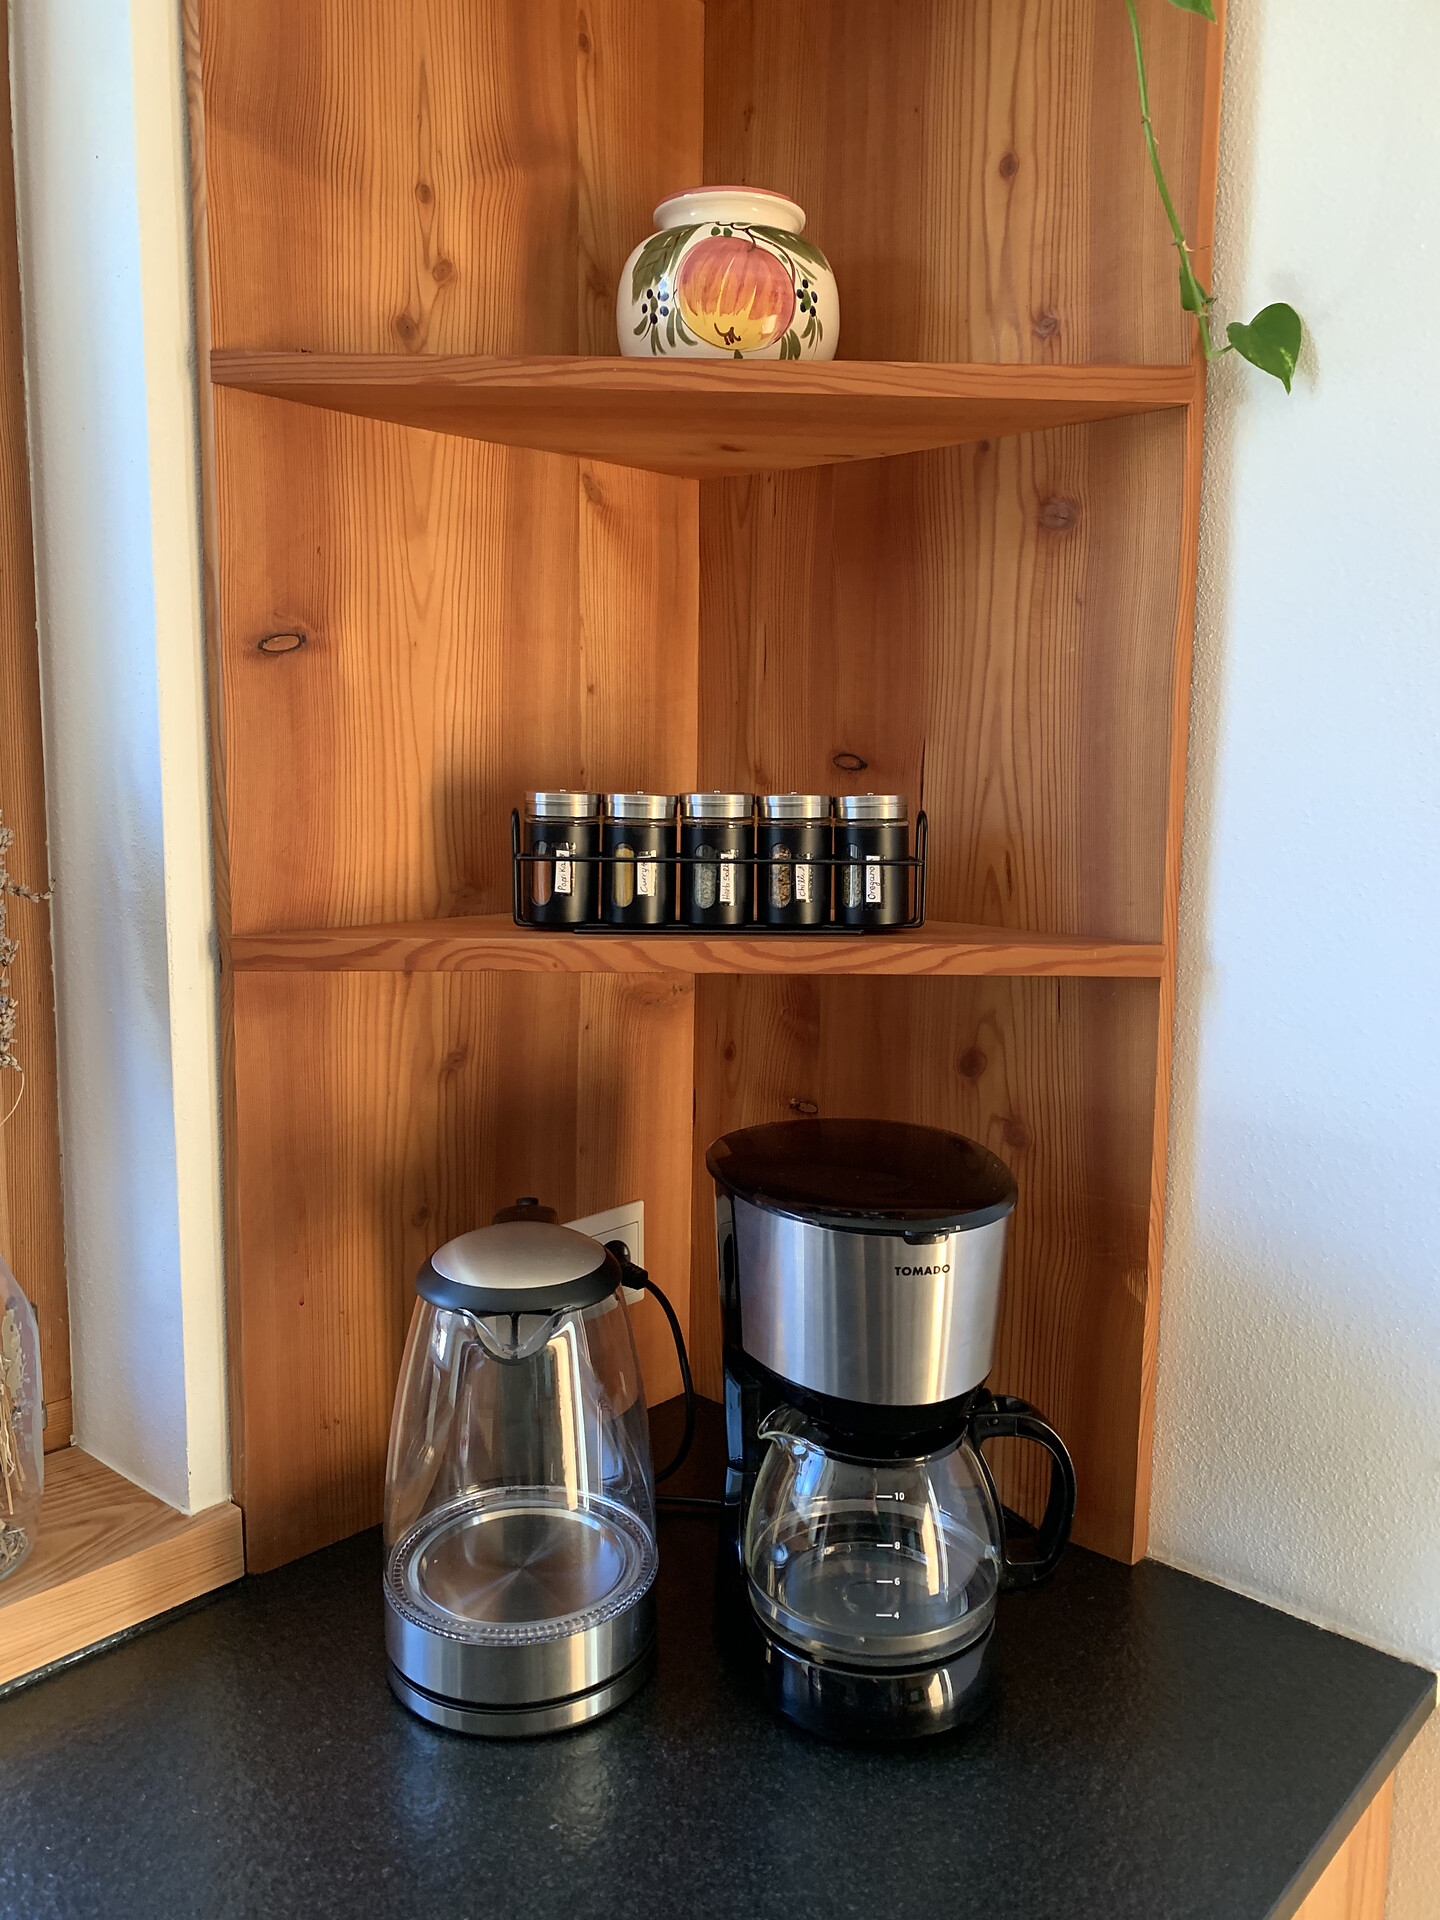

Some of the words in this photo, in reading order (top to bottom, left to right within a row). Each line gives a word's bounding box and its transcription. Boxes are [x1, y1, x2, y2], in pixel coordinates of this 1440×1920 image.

[867, 866, 880, 900] Oregano
[895, 1264, 950, 1276] TOMADO
[894, 1492, 905, 1500] 10
[894, 1541, 901, 1550] 8
[894, 1577, 901, 1586] 6
[893, 1611, 900, 1620] 4
